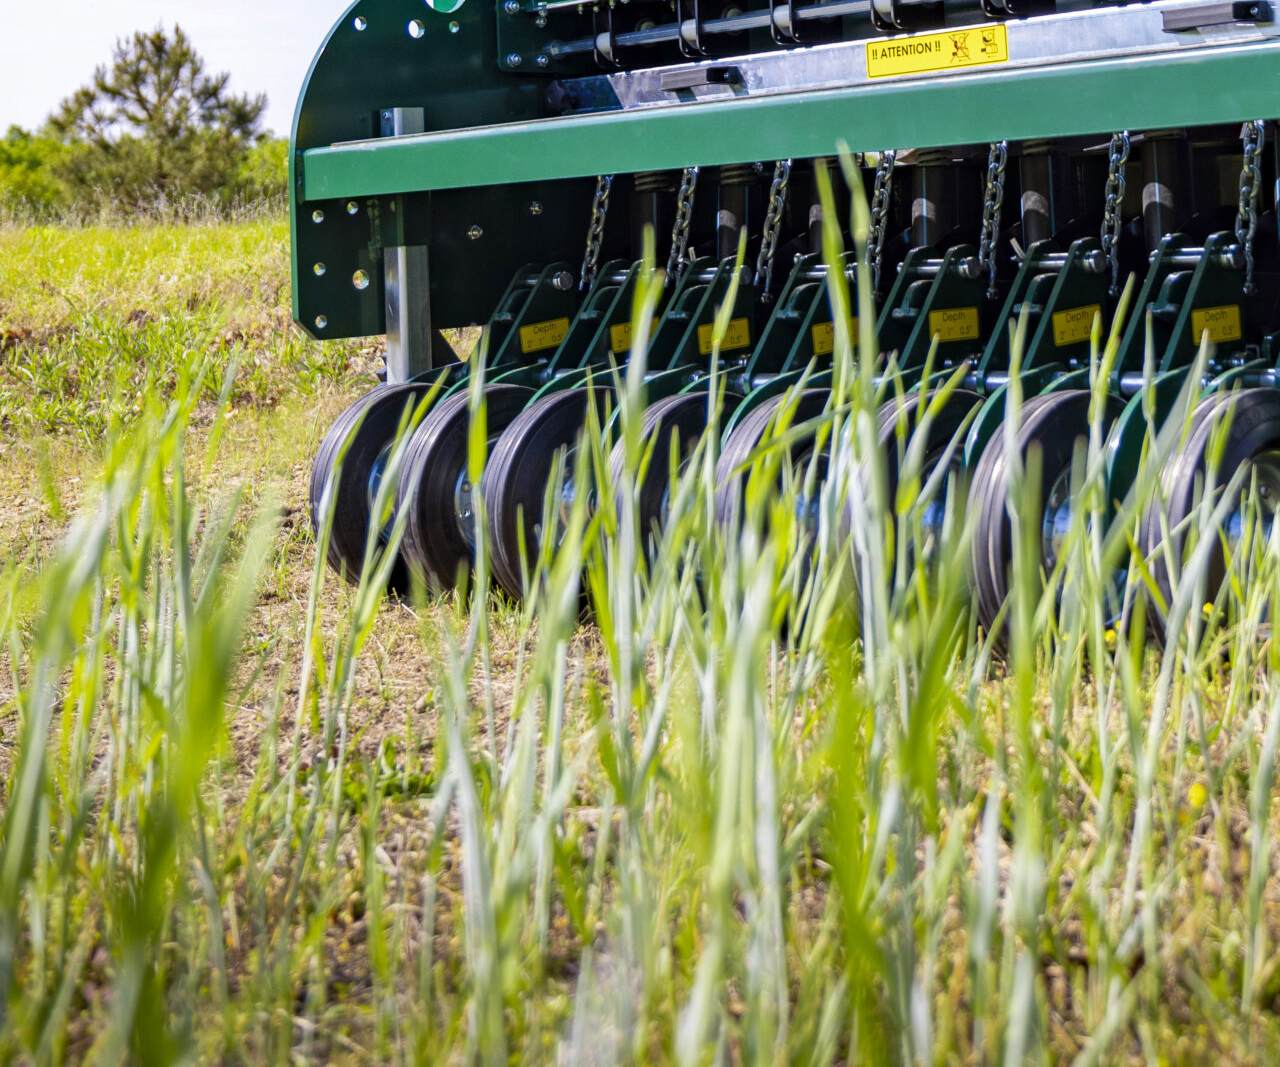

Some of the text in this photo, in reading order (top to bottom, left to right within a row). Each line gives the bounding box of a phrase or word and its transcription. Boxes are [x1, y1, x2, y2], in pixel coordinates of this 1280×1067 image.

[880, 42, 932, 60] ATTENTION
[943, 311, 966, 322] Depth
[1065, 309, 1089, 323] Depth
[533, 323, 557, 335] Depth
